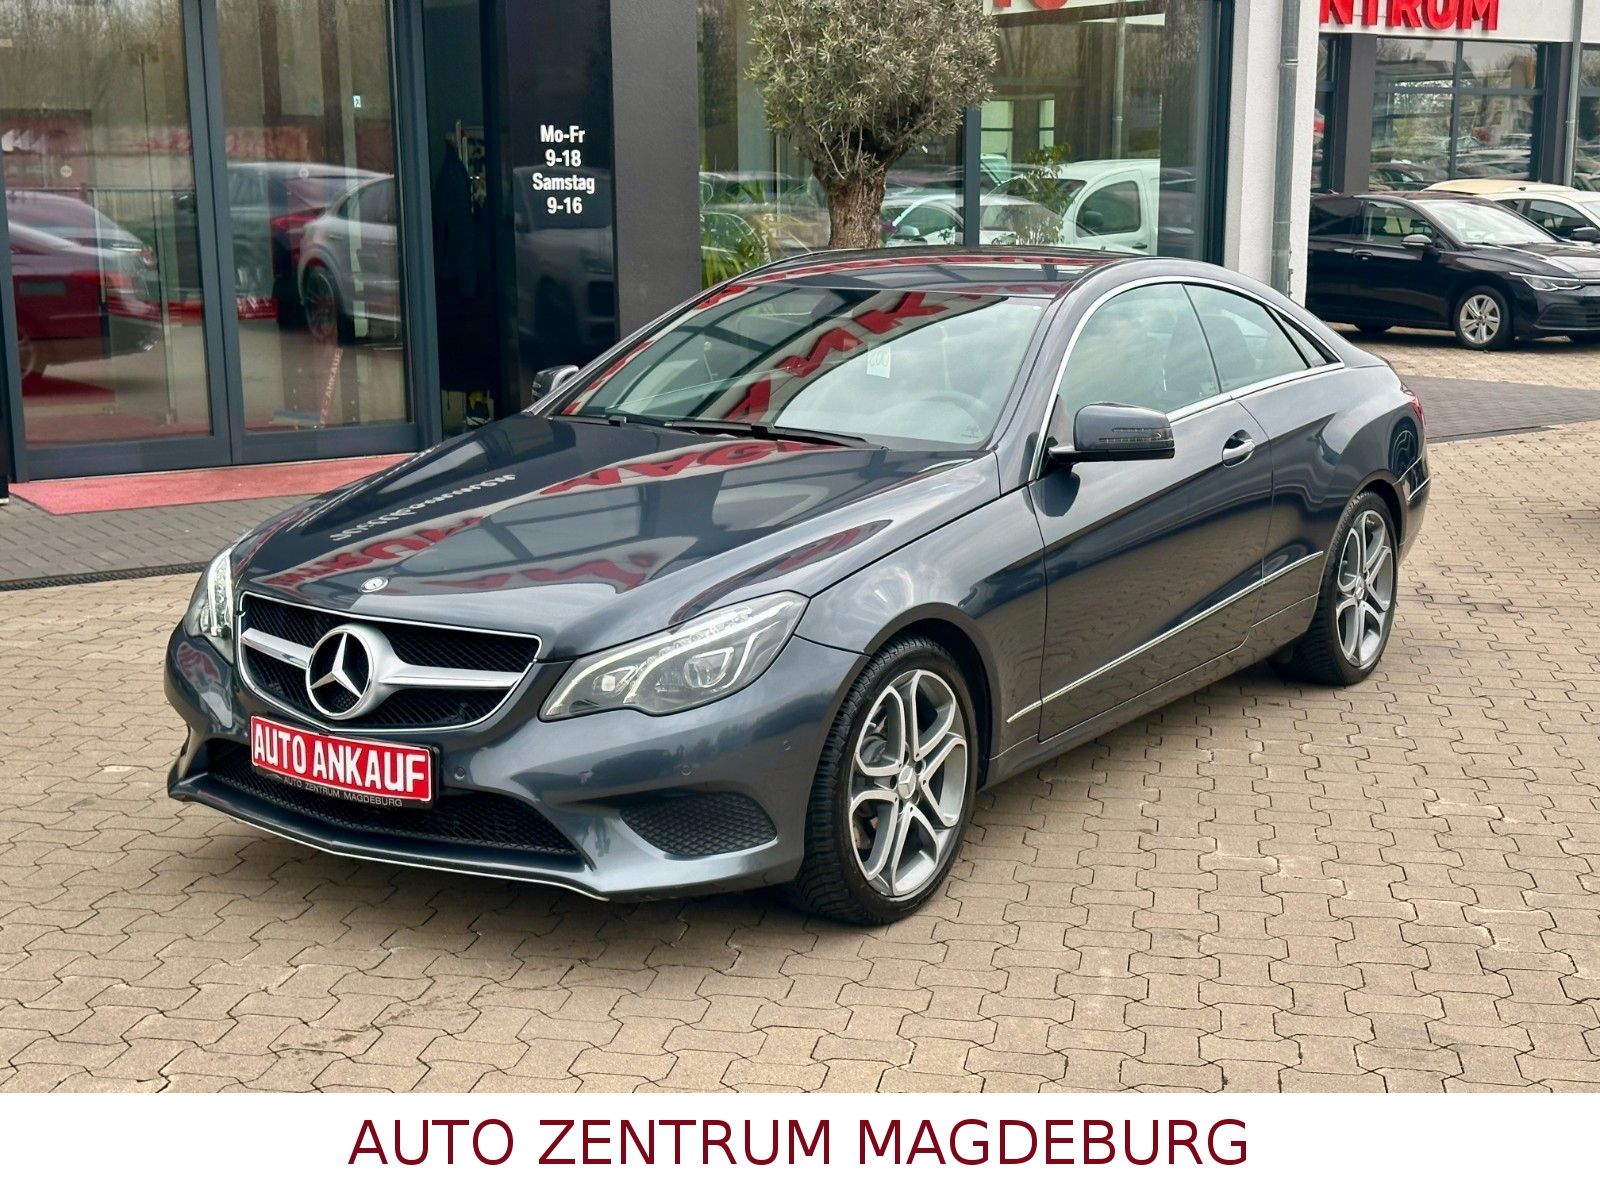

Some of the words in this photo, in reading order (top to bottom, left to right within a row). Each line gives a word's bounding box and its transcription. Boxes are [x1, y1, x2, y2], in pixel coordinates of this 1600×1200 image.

[540, 124, 586, 143] Mo-Fr
[545, 148, 582, 167] 9-18
[532, 172, 596, 195] Samstag
[546, 196, 583, 214] 9-16
[254, 723, 307, 775] AUTO
[313, 740, 426, 792] ANKAUF
[283, 776, 303, 789] AUTO
[305, 783, 340, 797] ZENTRUM
[344, 791, 403, 807] MAGDEBURG
